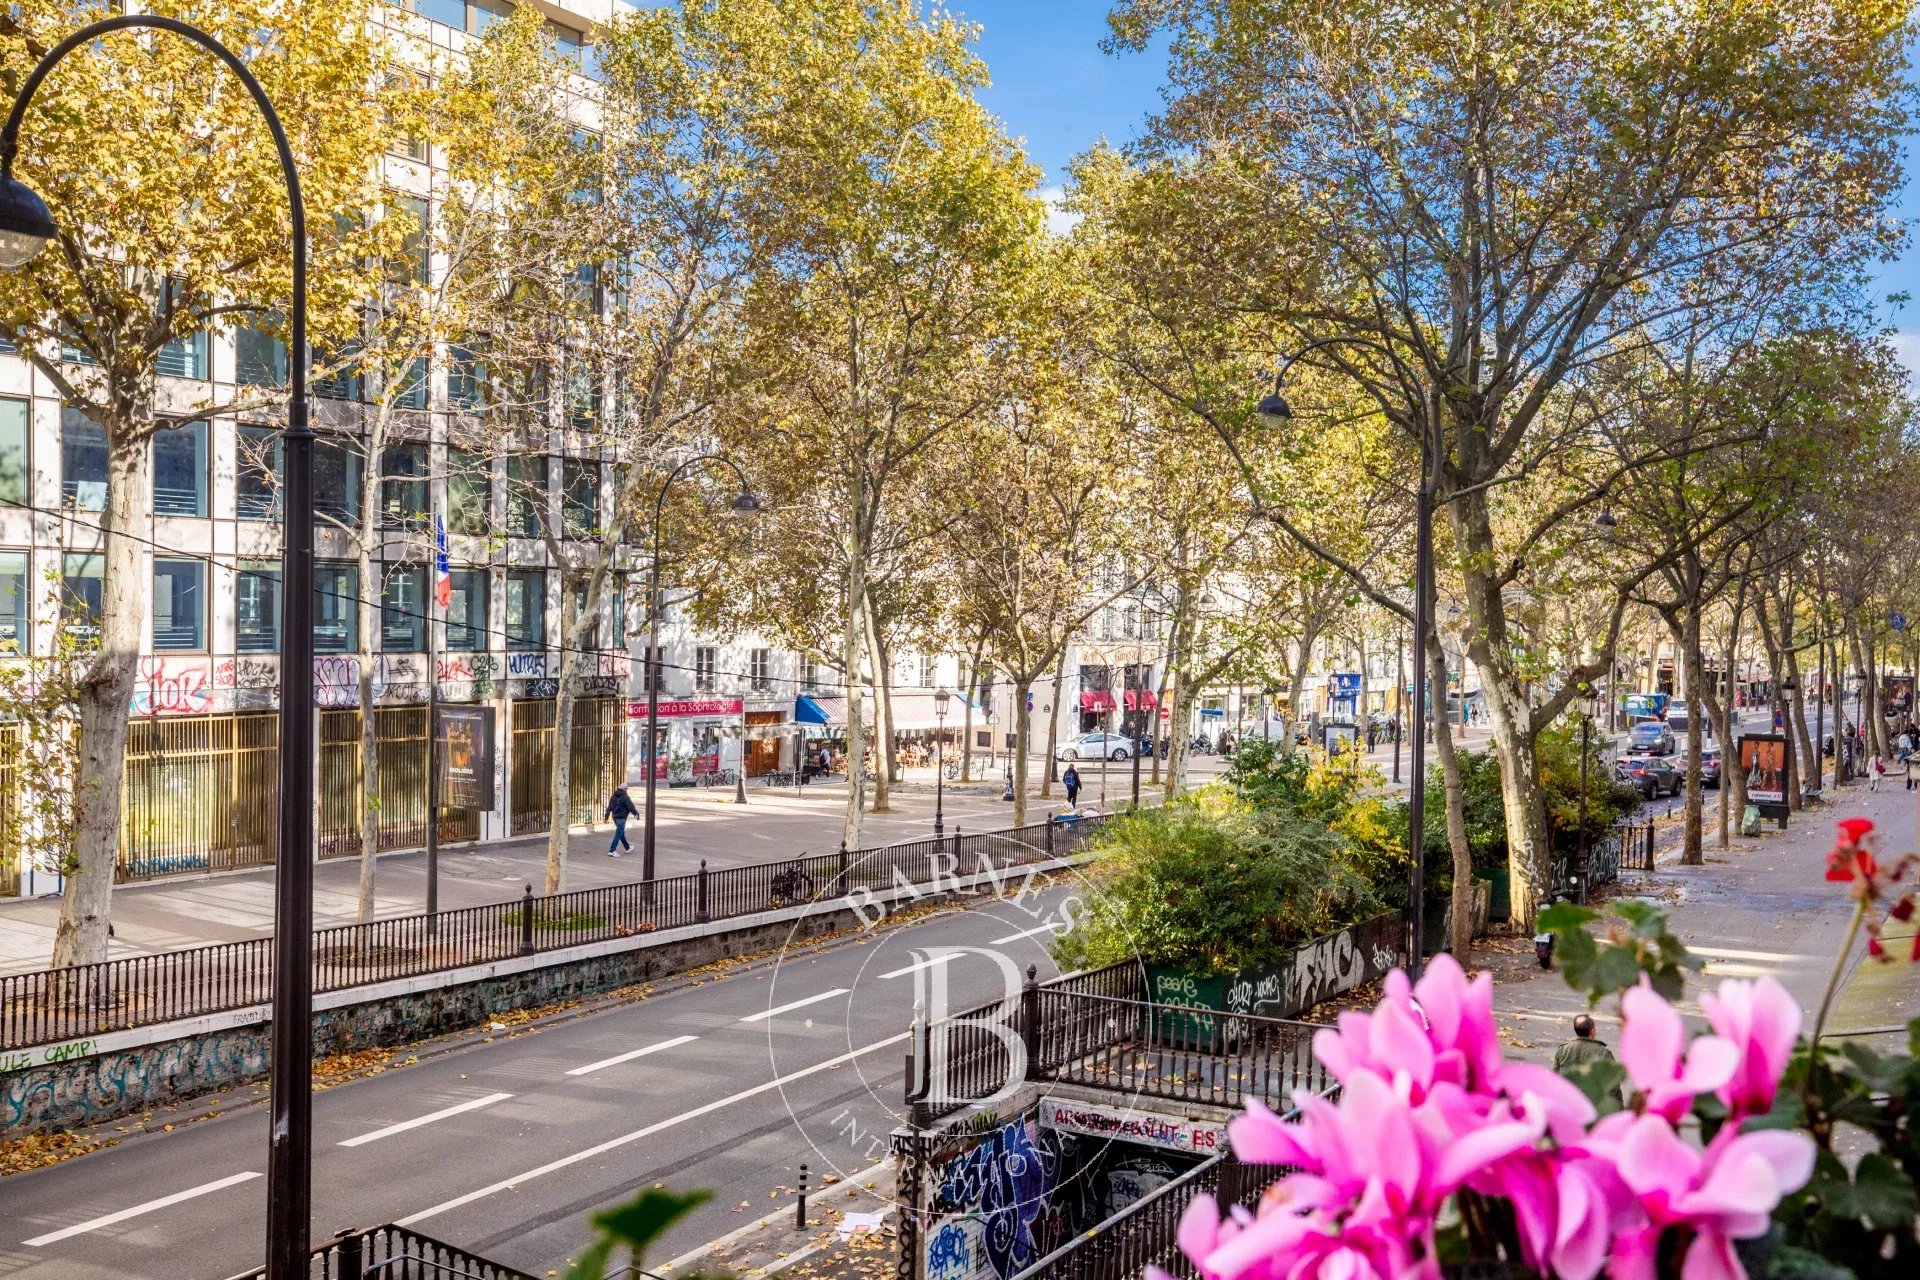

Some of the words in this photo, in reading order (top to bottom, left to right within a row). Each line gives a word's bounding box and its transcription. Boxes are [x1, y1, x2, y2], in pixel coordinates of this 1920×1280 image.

[629, 703, 670, 715] Formion
[671, 701, 679, 713] à
[688, 701, 734, 714] Sophrologie
[44, 1039, 98, 1063] CAMP!
